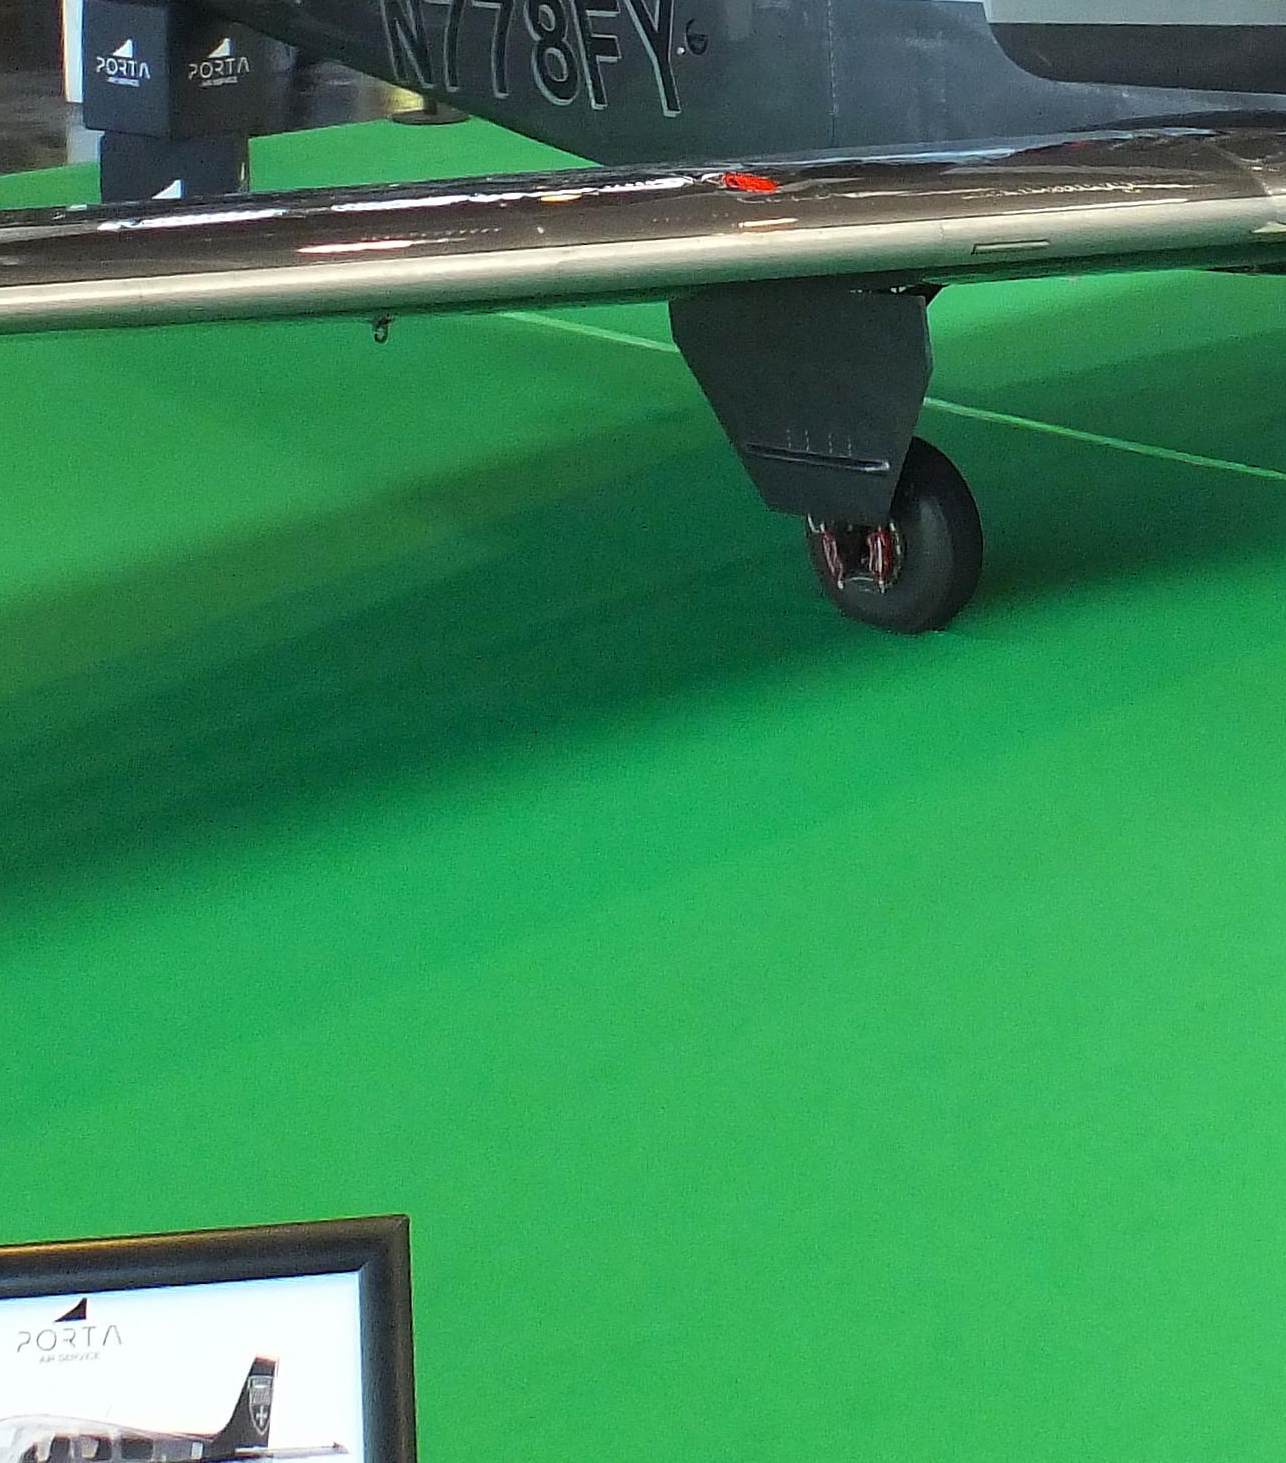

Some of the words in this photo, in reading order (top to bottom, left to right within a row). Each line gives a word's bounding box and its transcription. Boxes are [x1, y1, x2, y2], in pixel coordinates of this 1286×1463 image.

[96, 56, 151, 80] PORTA
[188, 57, 251, 81] PORTA
[17, 1324, 122, 1353] PORTA
